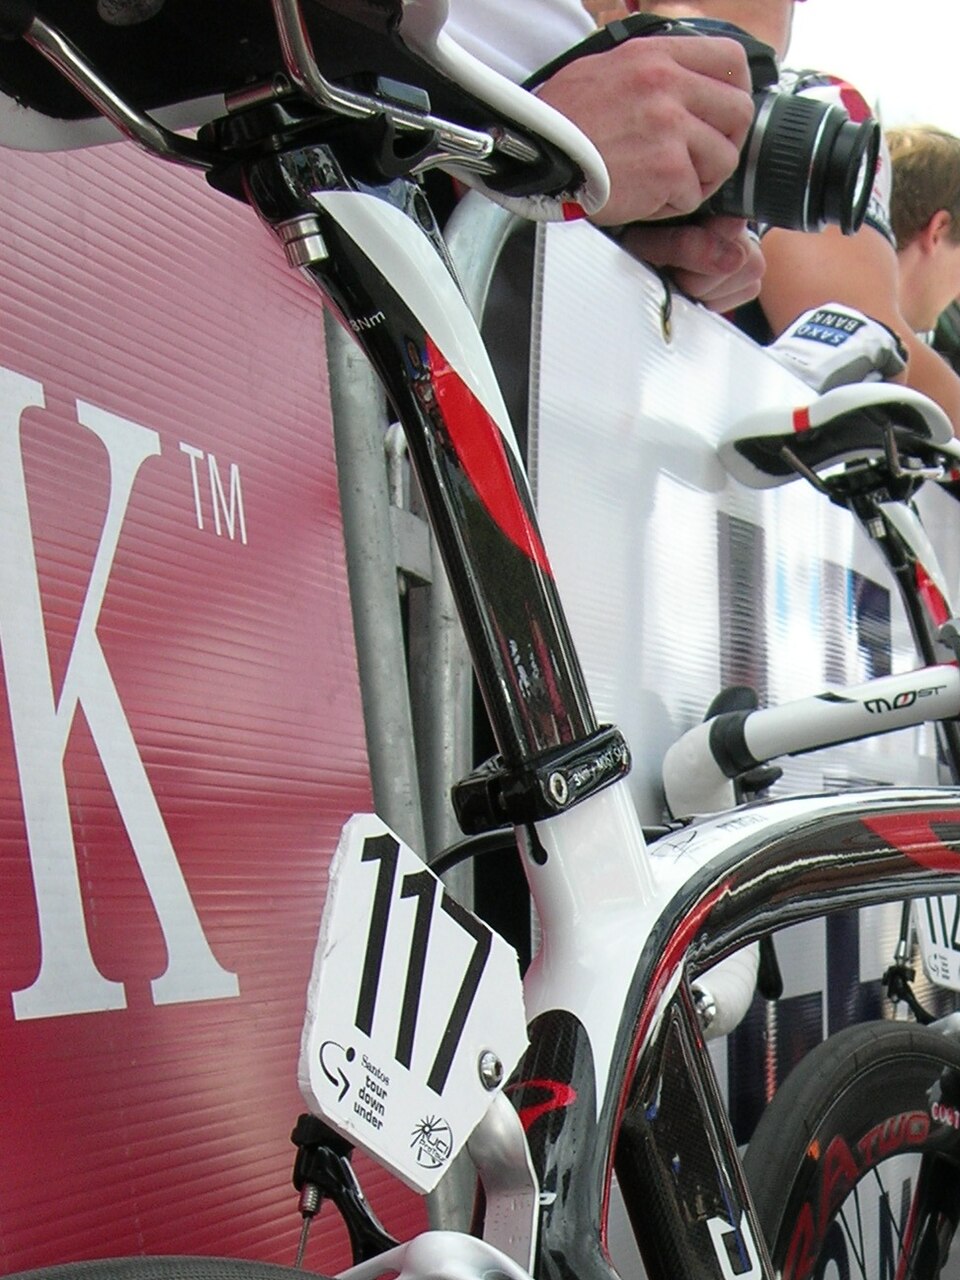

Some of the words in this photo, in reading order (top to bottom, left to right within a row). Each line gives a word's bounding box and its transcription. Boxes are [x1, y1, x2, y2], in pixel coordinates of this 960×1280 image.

[797, 325, 846, 345] SAXO
[812, 312, 859, 332] BANK
[353, 832, 493, 1097] 117
[361, 1054, 390, 1086] Santos
[358, 1087, 385, 1116] down
[365, 1075, 388, 1099] tour
[354, 1102, 383, 1131] under
